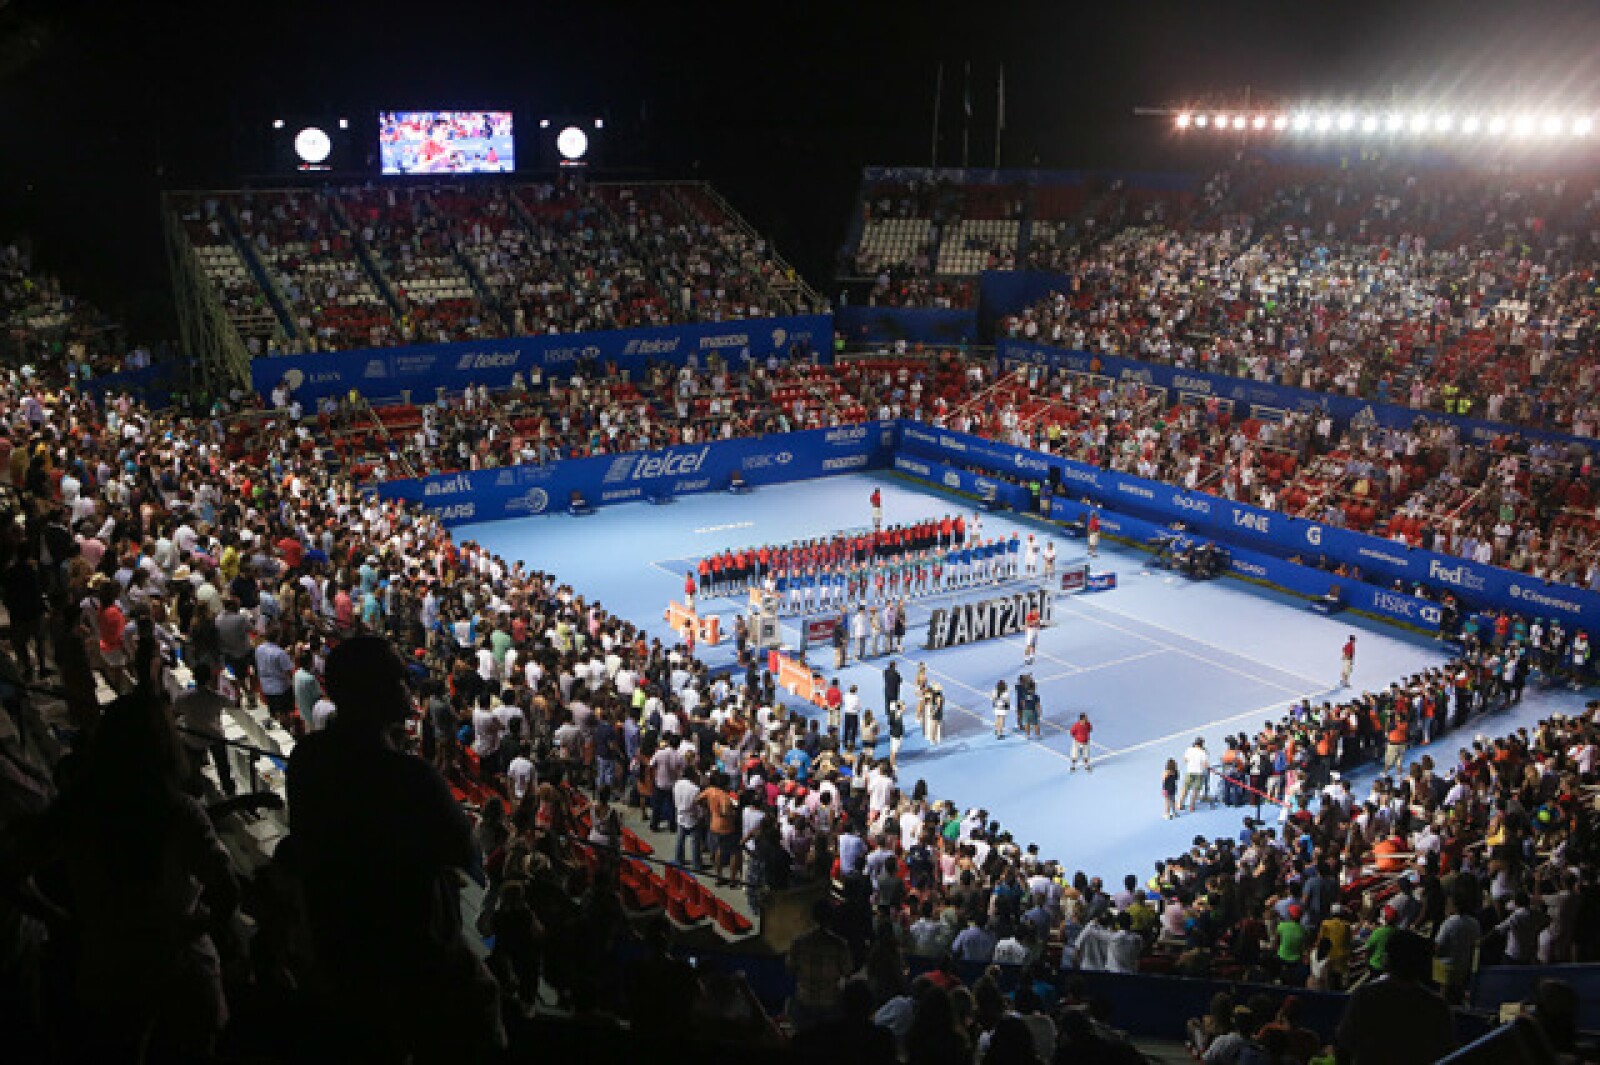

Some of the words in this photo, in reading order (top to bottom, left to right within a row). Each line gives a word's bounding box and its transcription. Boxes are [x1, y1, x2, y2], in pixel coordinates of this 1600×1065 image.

[632, 446, 710, 481] telcel
[1232, 510, 1270, 533] TANE
[1306, 526, 1322, 546] G
[1429, 559, 1486, 591] FedEx
[1374, 591, 1417, 618] HSBC
